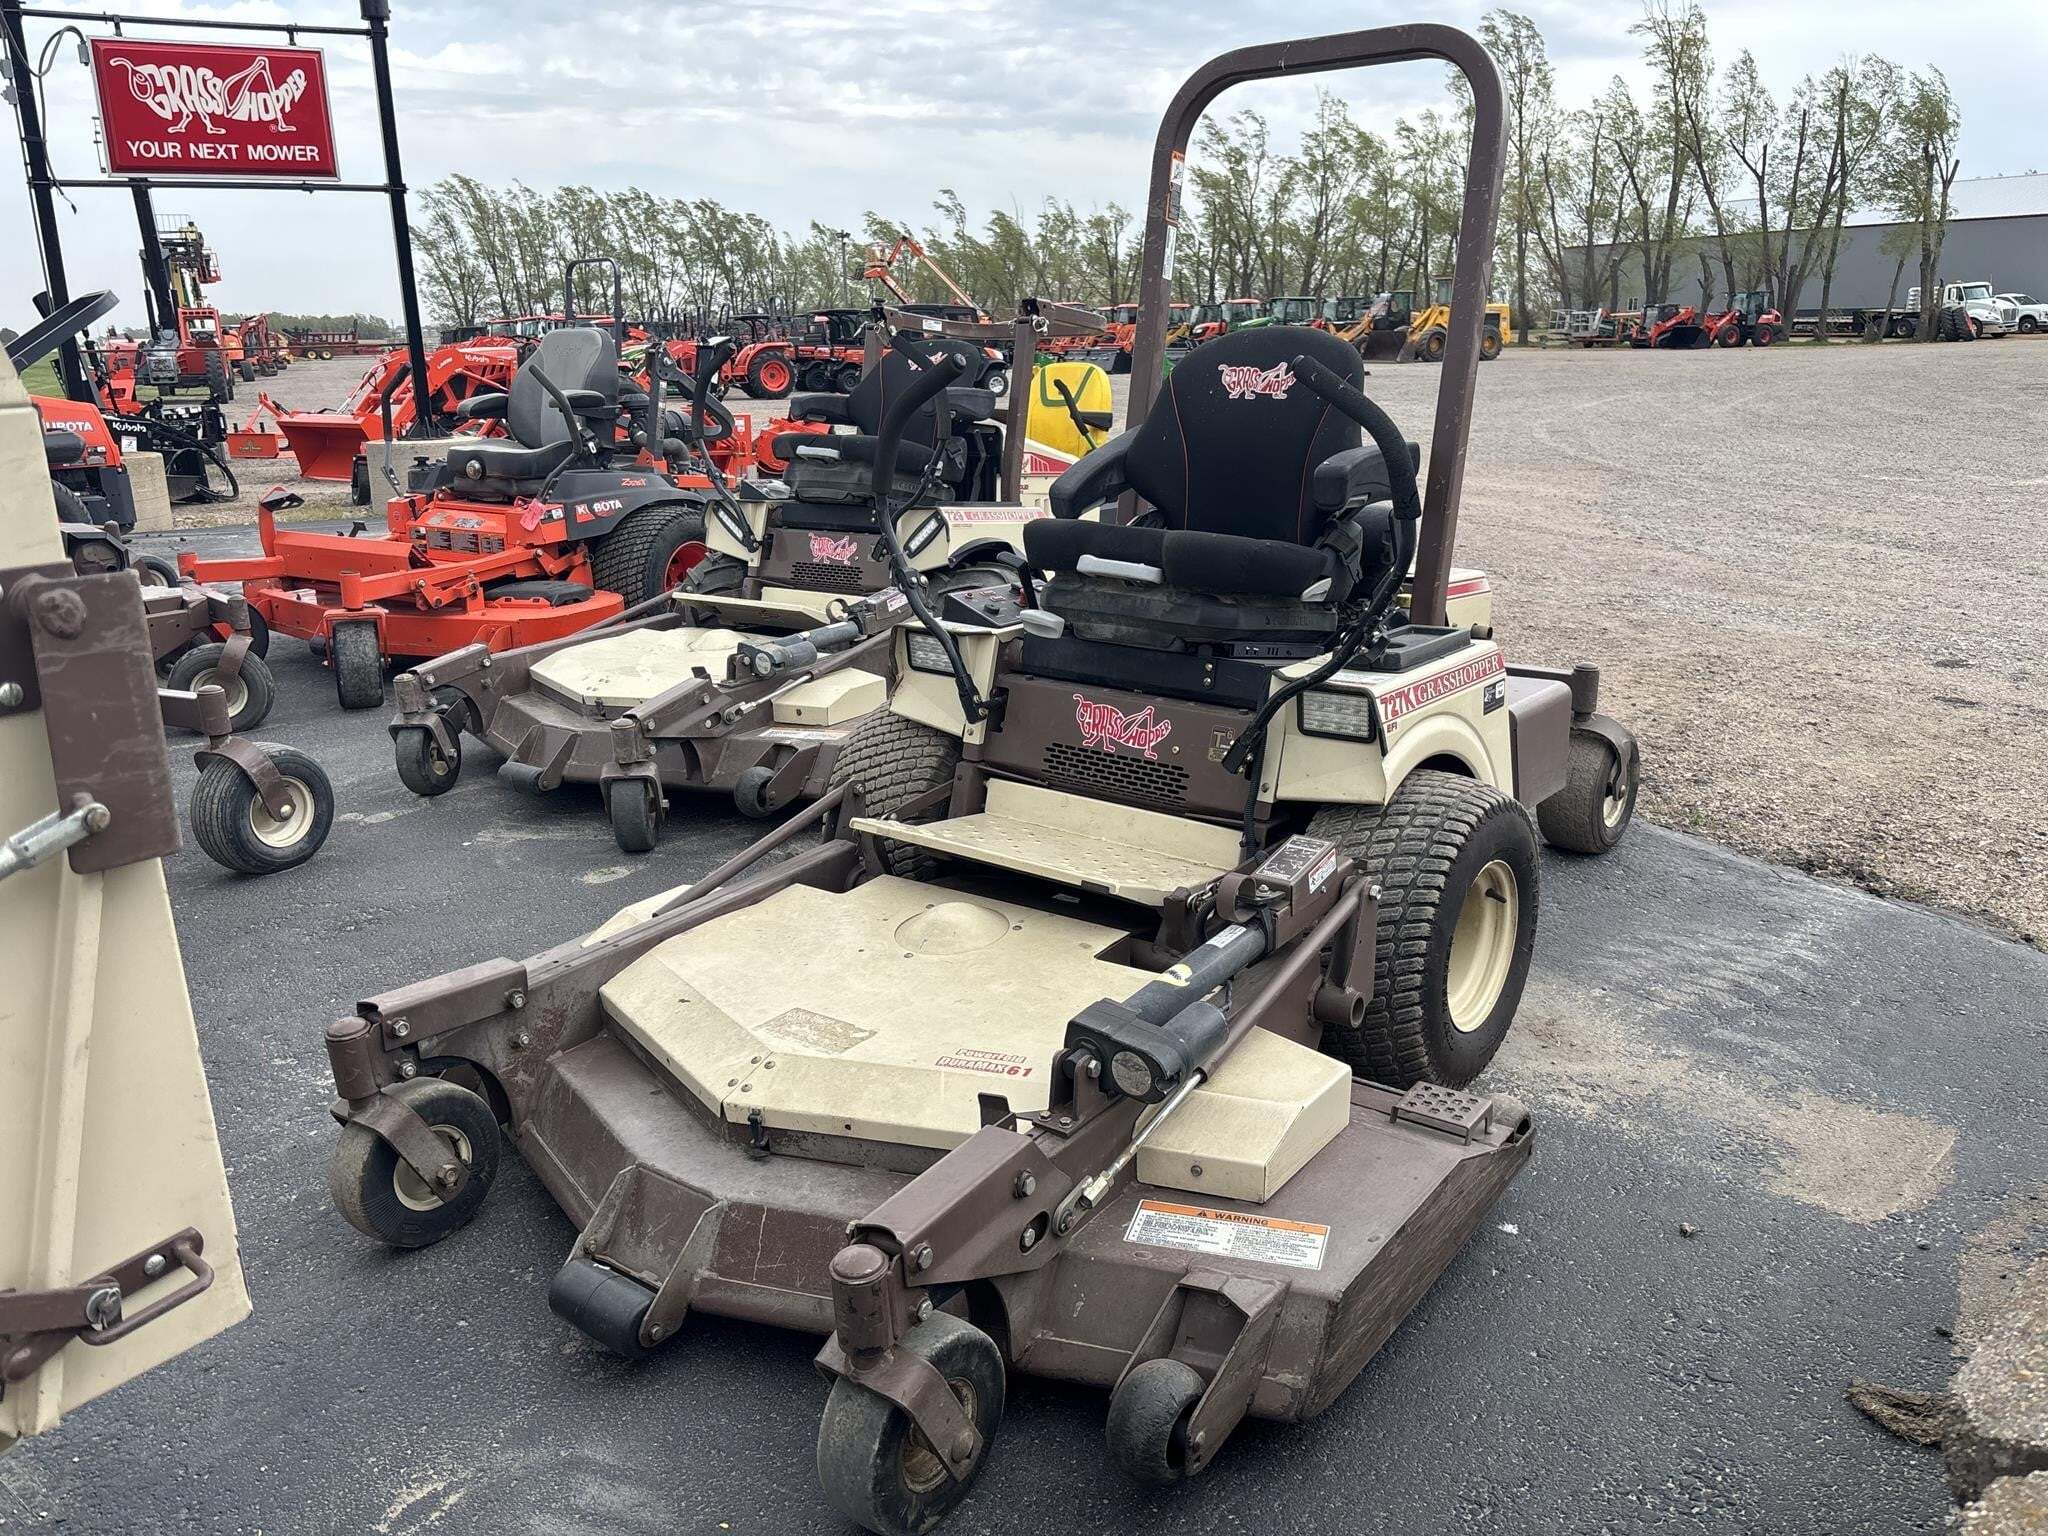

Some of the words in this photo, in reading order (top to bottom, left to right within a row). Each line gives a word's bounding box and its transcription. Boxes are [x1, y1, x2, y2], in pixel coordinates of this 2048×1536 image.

[130, 58, 308, 124] GRASSHOPPER
[126, 140, 182, 159] YOUR
[190, 142, 240, 160] NEXT
[247, 144, 320, 162] MOWER
[43, 421, 94, 432] UBOTA
[112, 421, 147, 433] Kubota
[1380, 686, 1416, 720] 727K
[1416, 654, 1500, 702] GRASSHOPPER
[1077, 701, 1171, 750] GRASSHOPPER
[1386, 722, 1398, 733] EFI
[1213, 1211, 1270, 1226] WARNING
